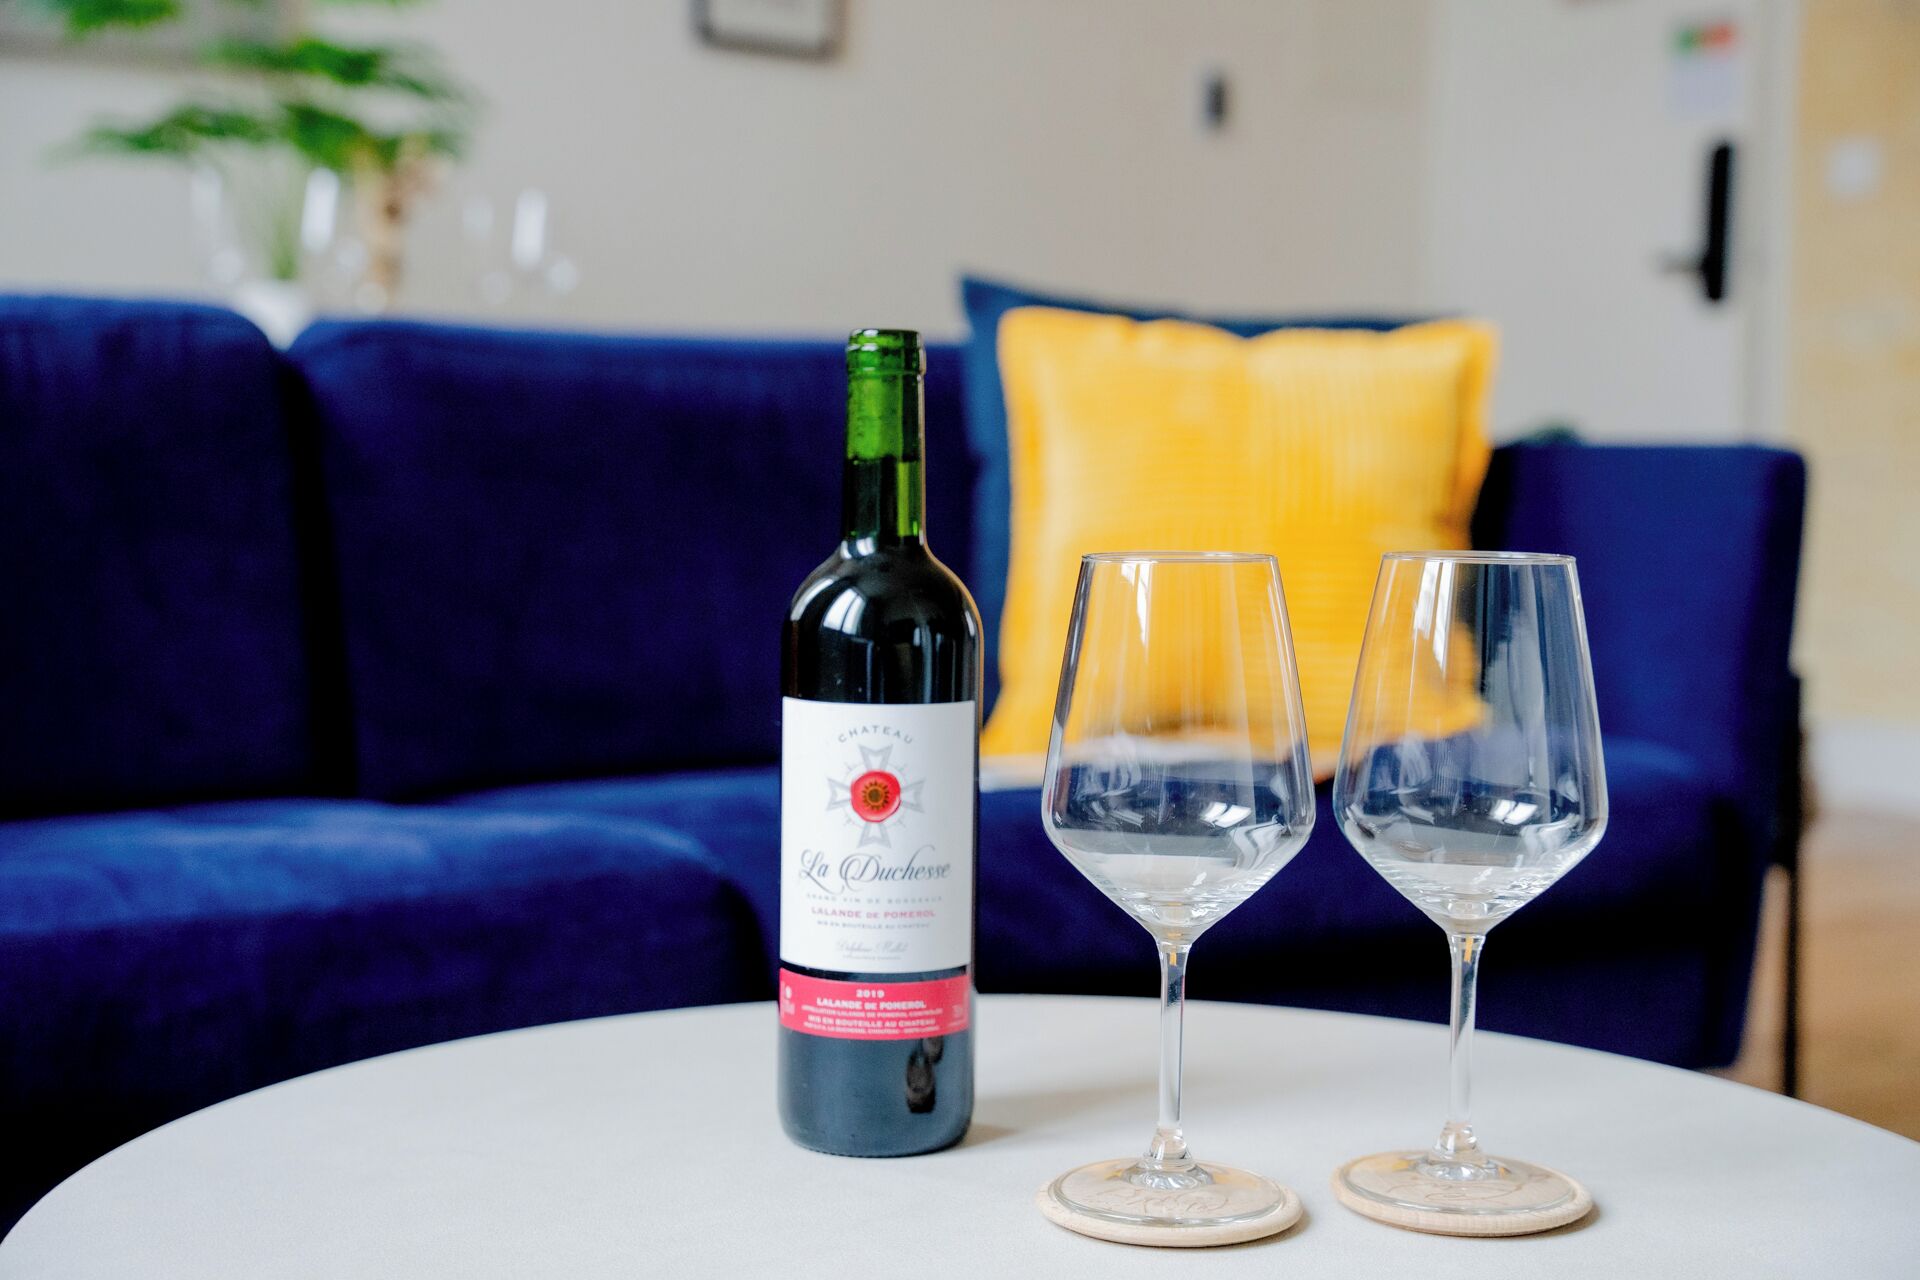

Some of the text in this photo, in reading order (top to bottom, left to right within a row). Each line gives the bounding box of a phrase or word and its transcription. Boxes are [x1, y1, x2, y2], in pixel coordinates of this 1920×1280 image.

[838, 724, 913, 744] CHATEAU
[799, 844, 952, 895] La Duchesse
[811, 906, 937, 920] LALANDE DE POMEROL
[855, 988, 885, 999] 2019
[816, 997, 927, 1010] LALANDE DE POMEROL
